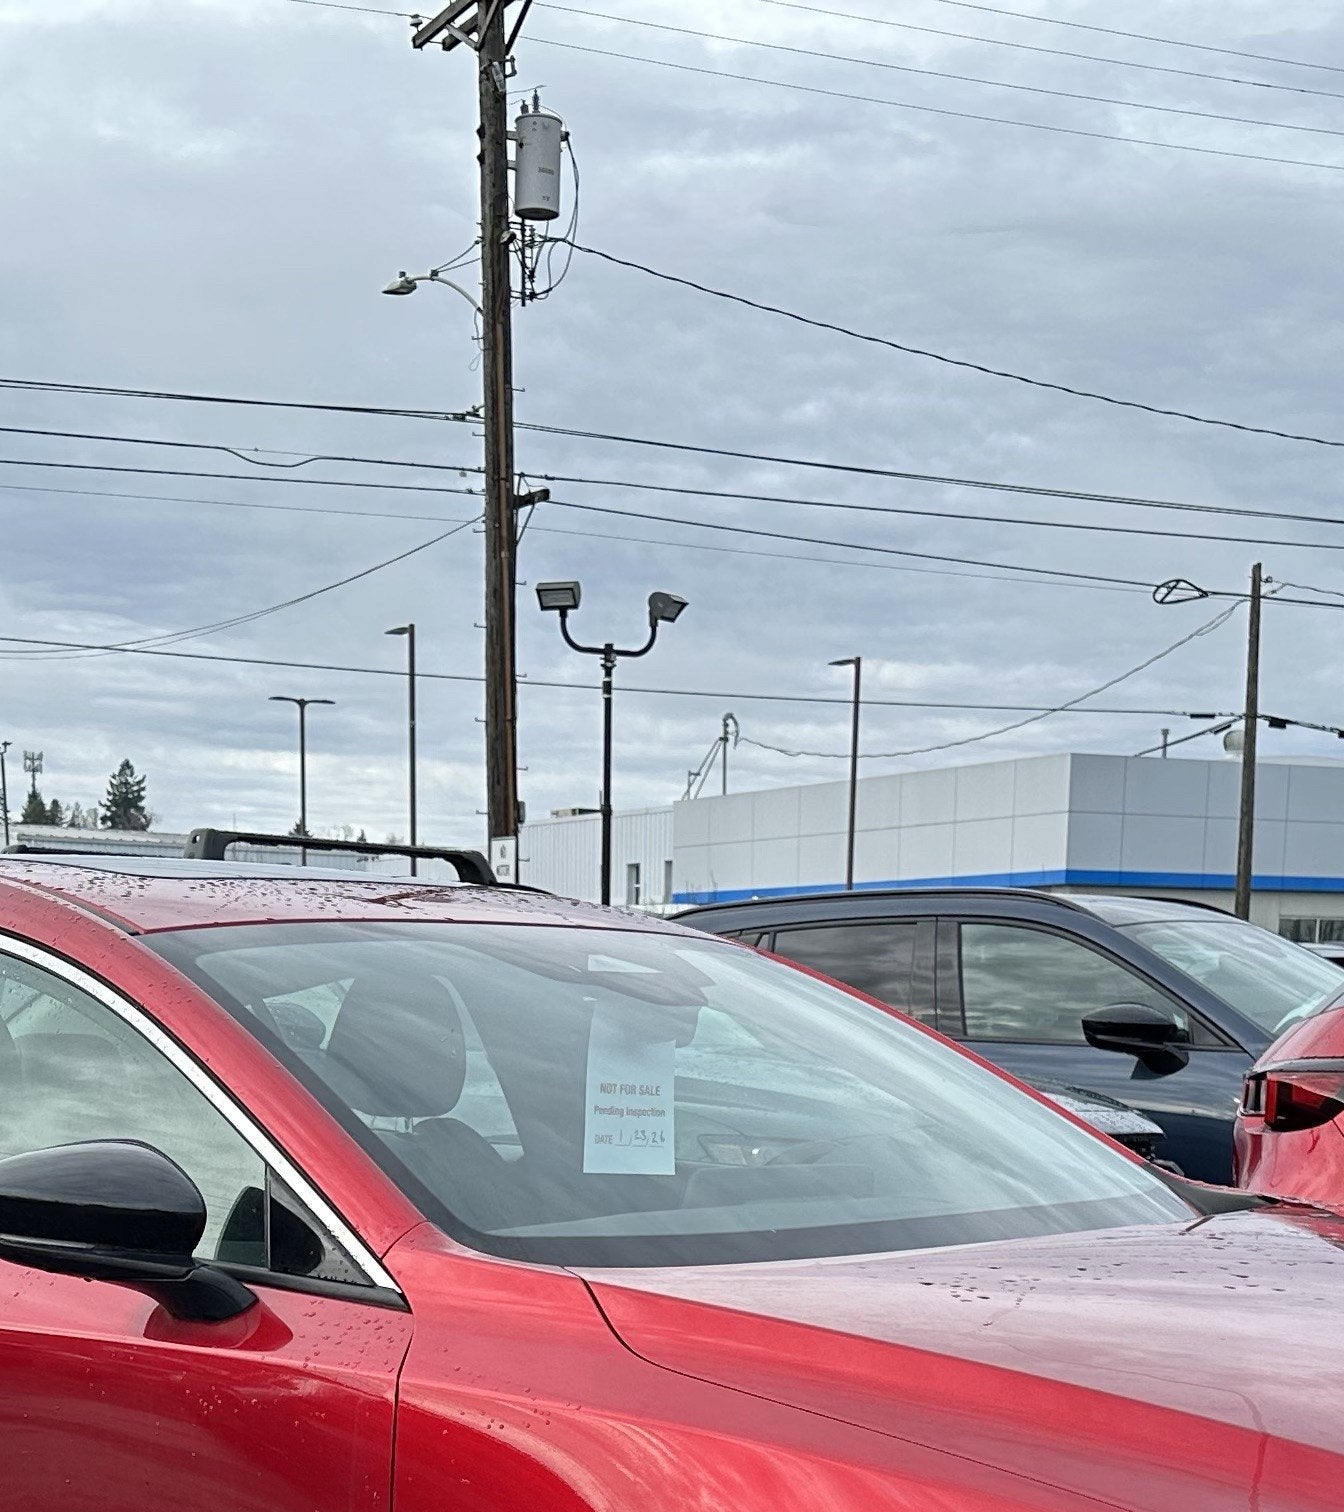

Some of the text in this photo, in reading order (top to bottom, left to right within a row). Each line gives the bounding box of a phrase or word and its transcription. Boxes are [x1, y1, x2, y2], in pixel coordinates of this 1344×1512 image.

[600, 1083, 660, 1096] NOT FOR SALE
[594, 1105, 624, 1118] Pending
[594, 1134, 613, 1144] DATE
